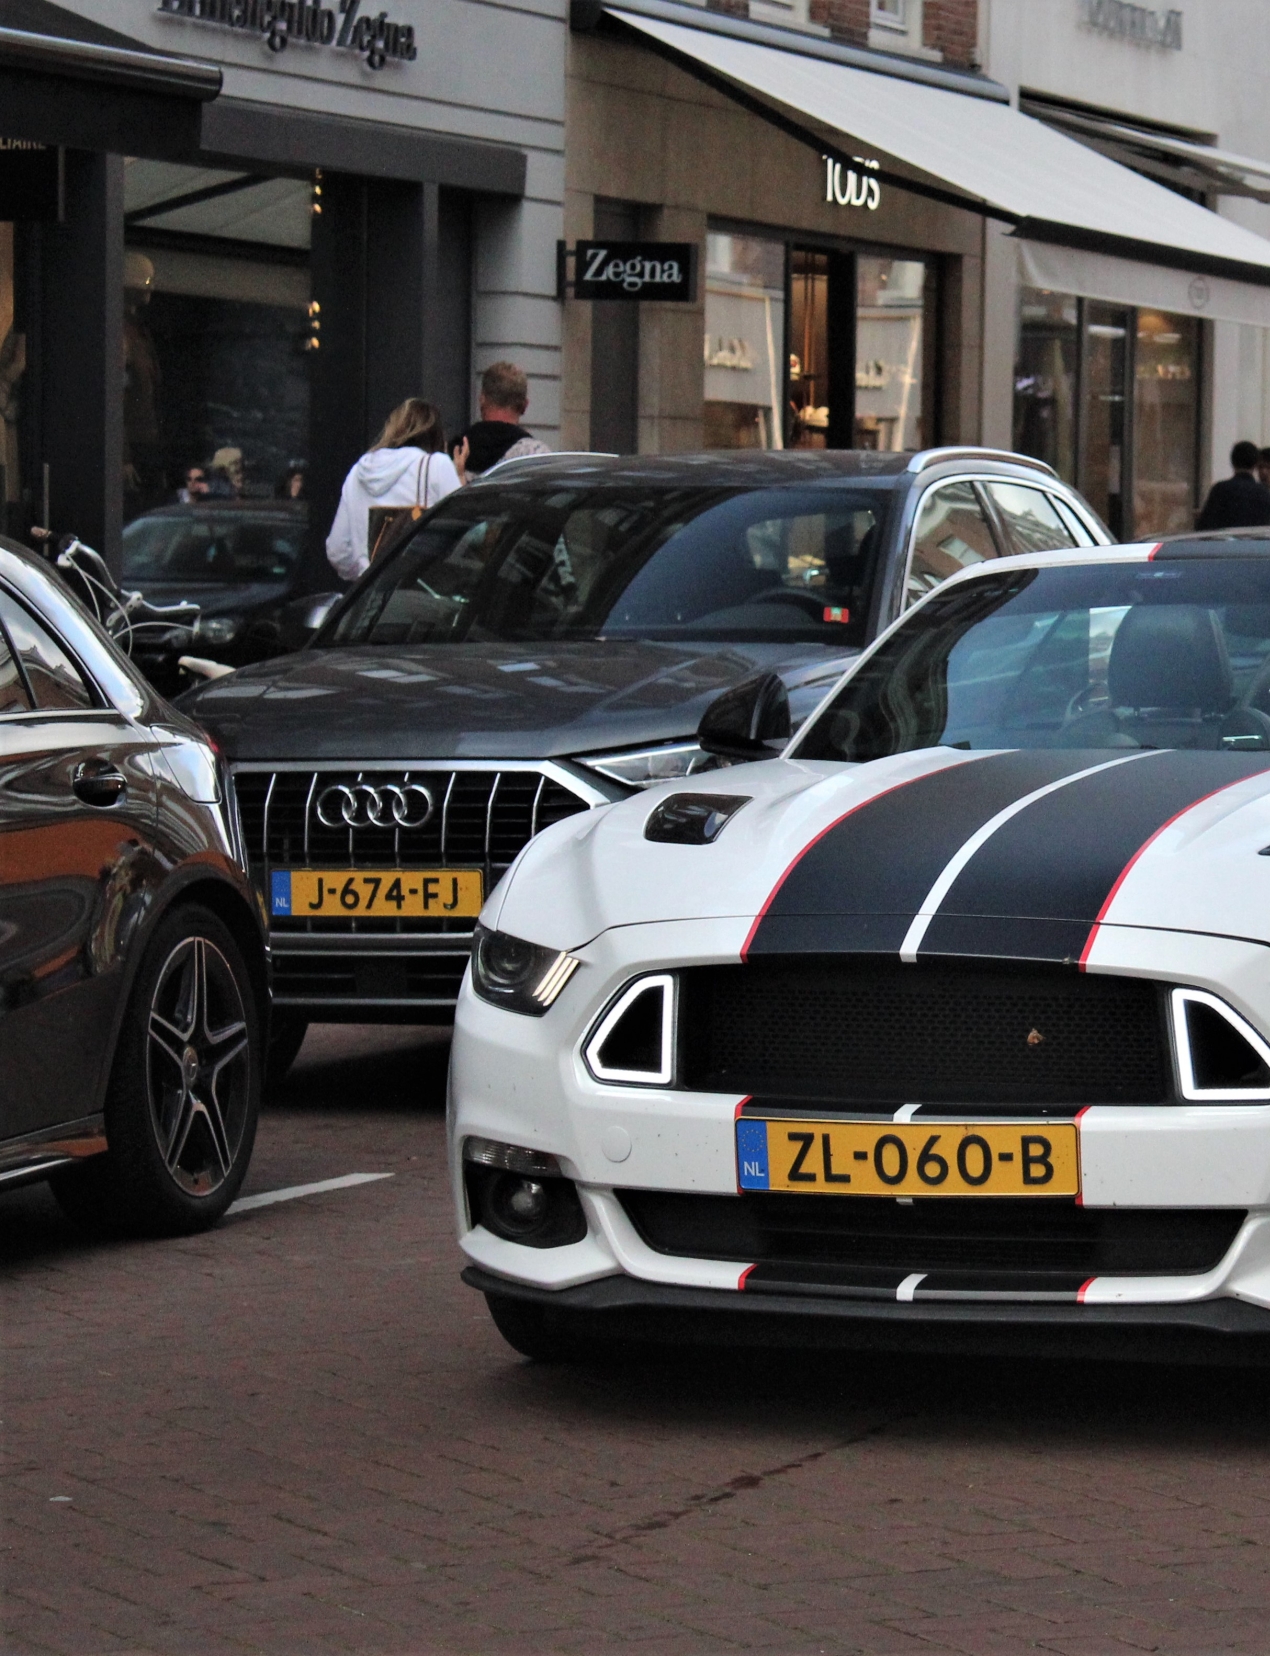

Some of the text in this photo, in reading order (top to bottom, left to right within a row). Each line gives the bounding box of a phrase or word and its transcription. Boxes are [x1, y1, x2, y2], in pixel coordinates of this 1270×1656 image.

[158, 0, 417, 70] menegildo Zegna
[583, 249, 682, 291] Zegna
[275, 877, 459, 910] NL J-674-FJ
[743, 1131, 1055, 1186] NL ZL-060-B
